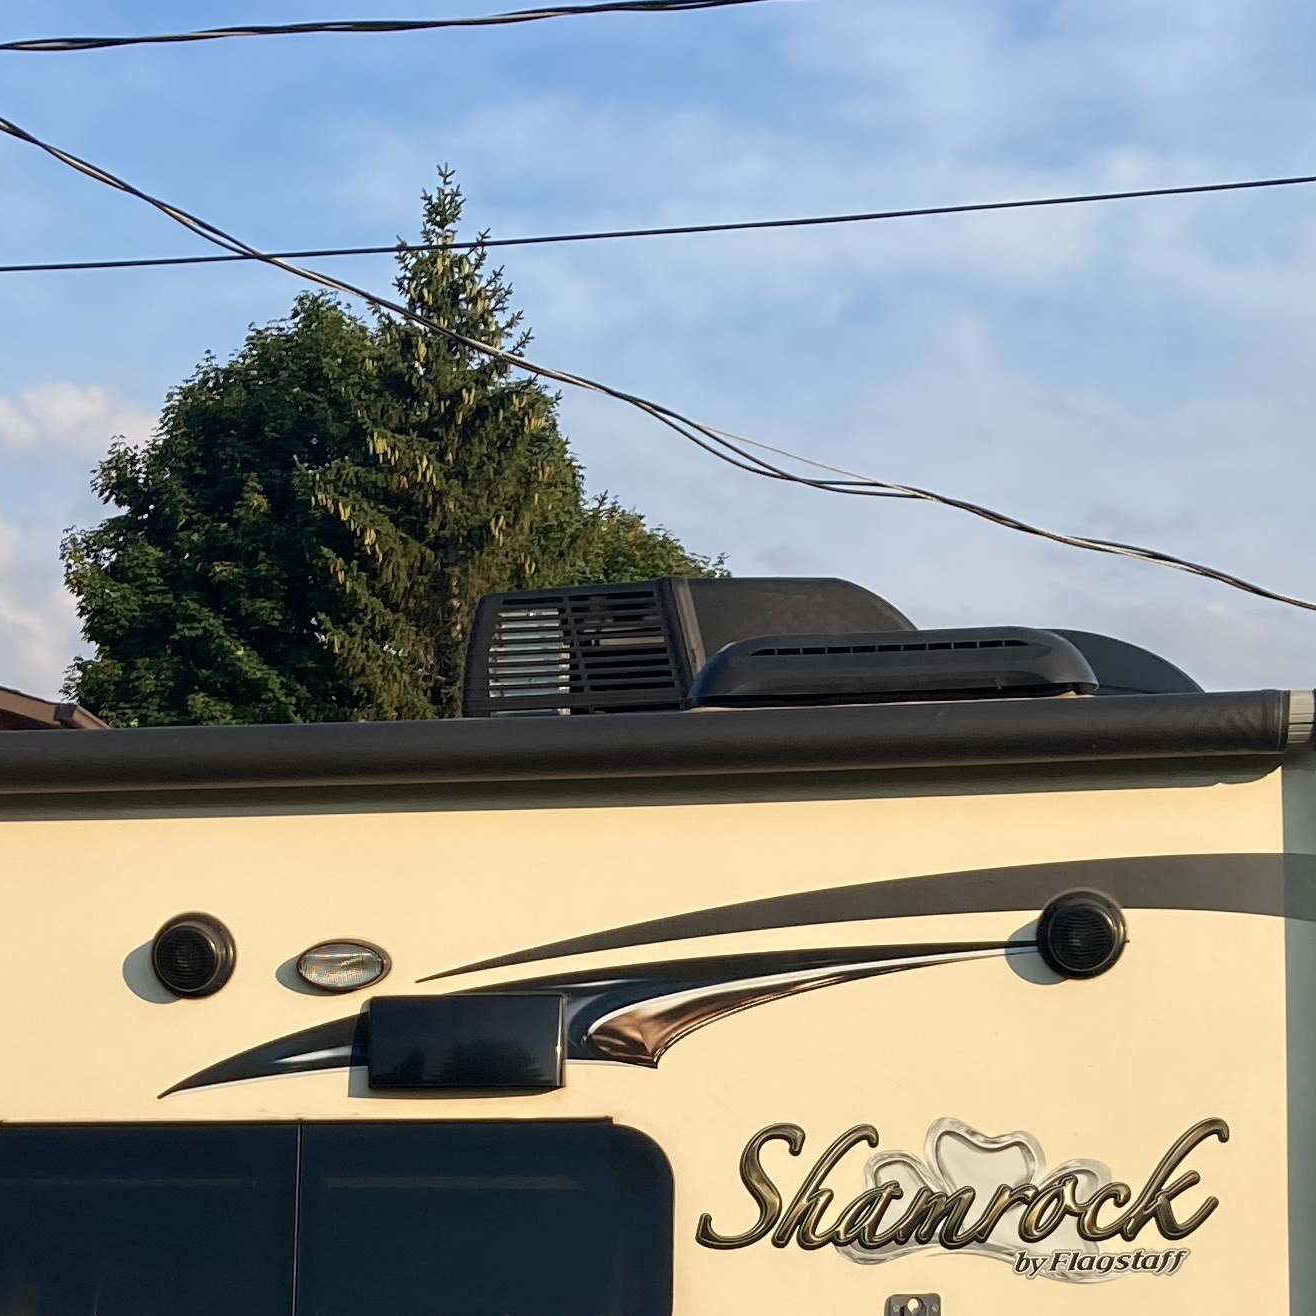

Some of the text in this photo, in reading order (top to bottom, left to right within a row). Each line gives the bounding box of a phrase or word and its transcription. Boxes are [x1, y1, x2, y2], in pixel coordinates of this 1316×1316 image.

[695, 1117, 1230, 1250] Shamrock
[1015, 1250, 1188, 1277] by Flagstaff
